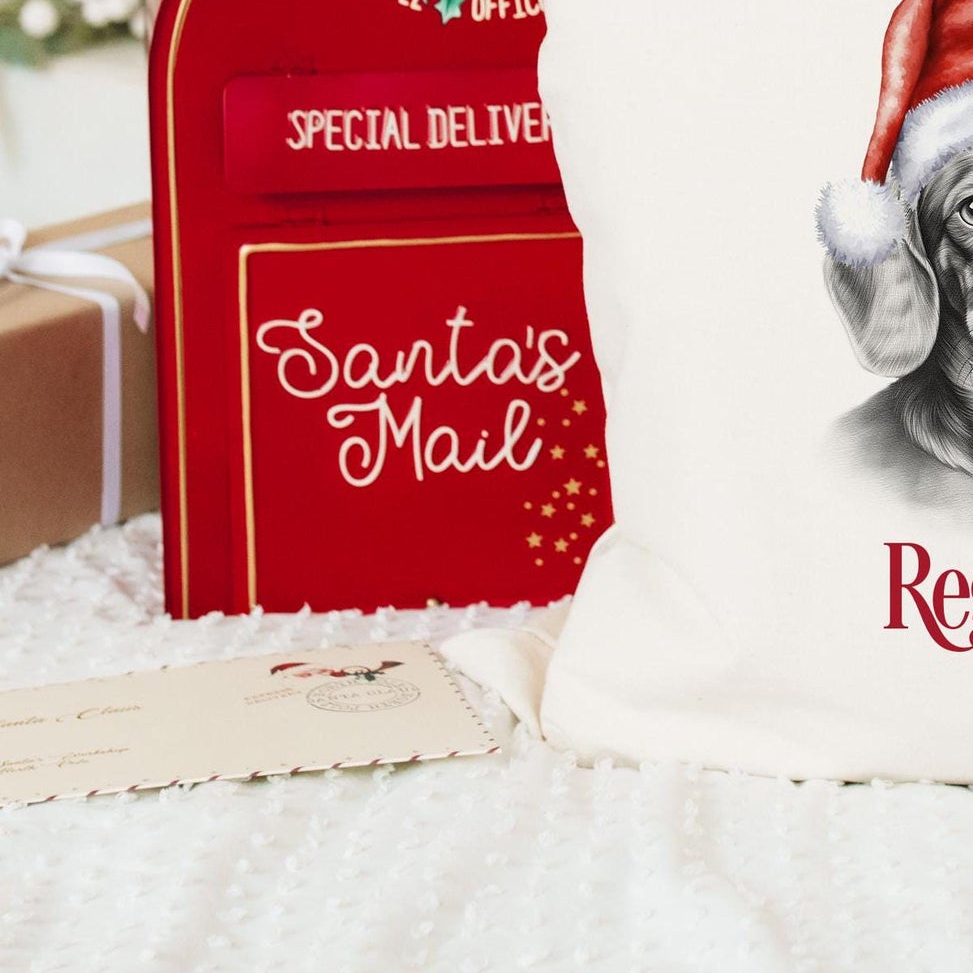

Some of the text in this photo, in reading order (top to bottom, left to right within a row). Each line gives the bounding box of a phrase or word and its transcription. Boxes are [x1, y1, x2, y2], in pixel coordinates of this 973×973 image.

[286, 107, 421, 151] SPECIAL
[256, 305, 581, 399] Santa's
[326, 392, 543, 487] Mail
